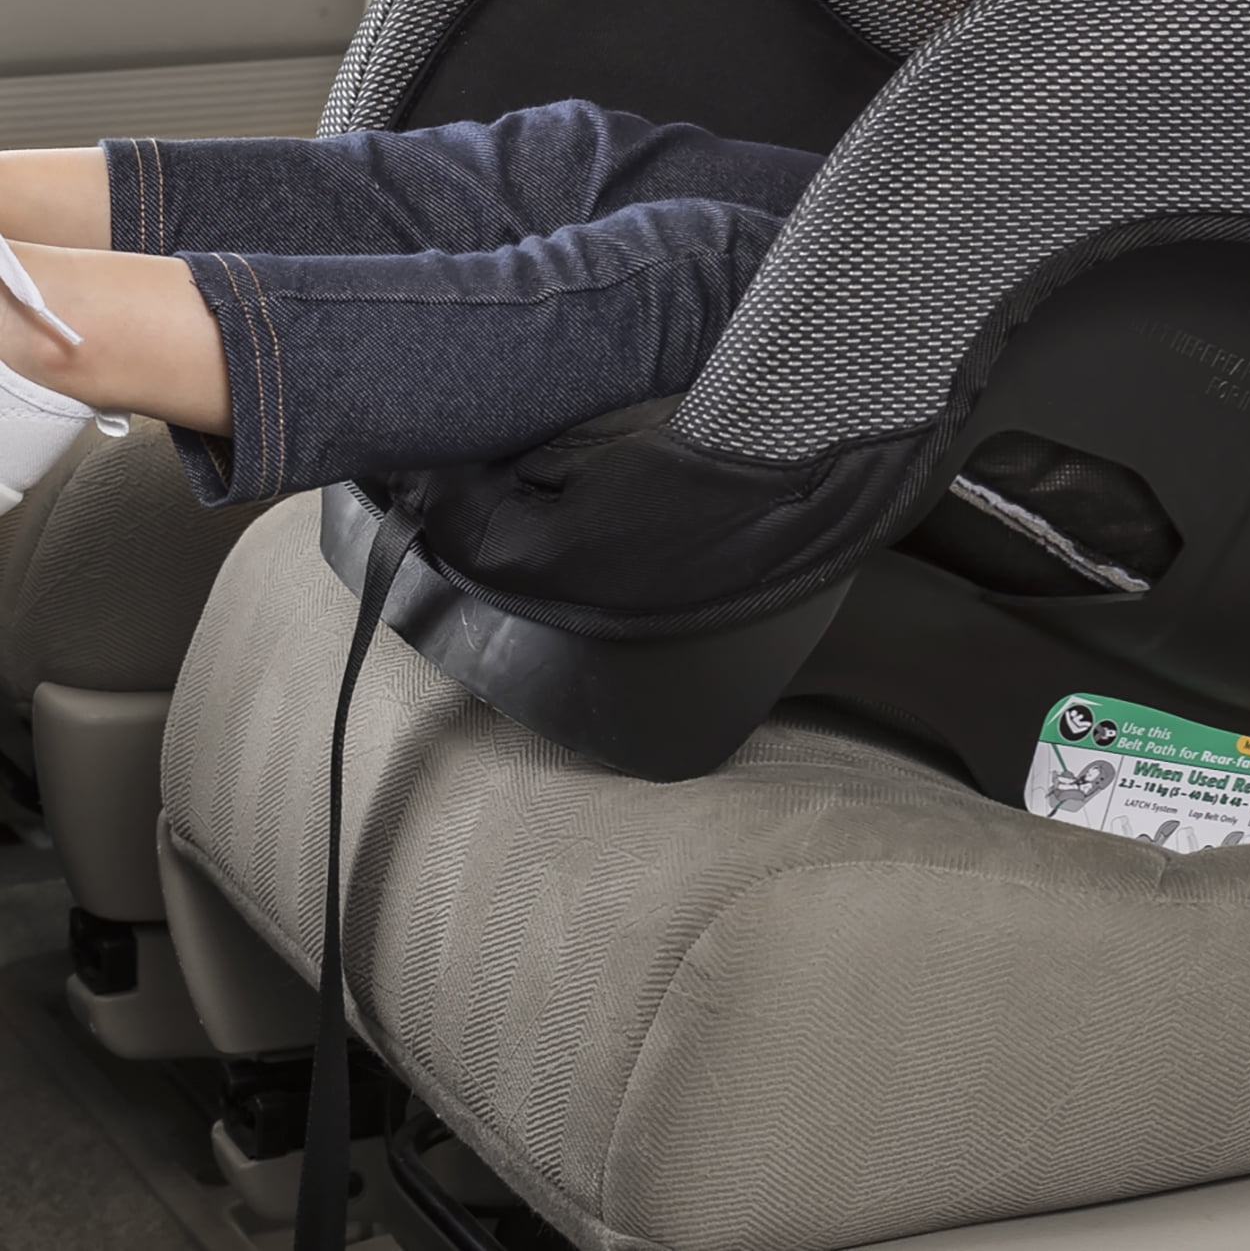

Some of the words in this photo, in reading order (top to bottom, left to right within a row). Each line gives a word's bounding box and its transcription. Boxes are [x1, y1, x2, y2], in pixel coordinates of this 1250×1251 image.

[1121, 721, 1145, 736] Use
[1147, 725, 1171, 740] this
[1116, 736, 1142, 751] Belt
[1144, 741, 1176, 756] Path
[1178, 746, 1198, 760] for
[1133, 761, 1183, 782] When
[1187, 769, 1229, 790] Used
[1118, 778, 1134, 789] 2.3
[1143, 782, 1155, 792] 18
[1156, 784, 1167, 796] kg
[1169, 786, 1179, 797] (5
[1188, 789, 1200, 799] 40
[1201, 791, 1216, 804] lbs)
[1219, 794, 1227, 804] &
[1229, 796, 1240, 806] 48
[1125, 798, 1148, 809] LATCH
[1150, 802, 1177, 814] System
[1188, 808, 1201, 820] Lap
[1204, 811, 1218, 821] Belt
[1220, 814, 1238, 825] Only
